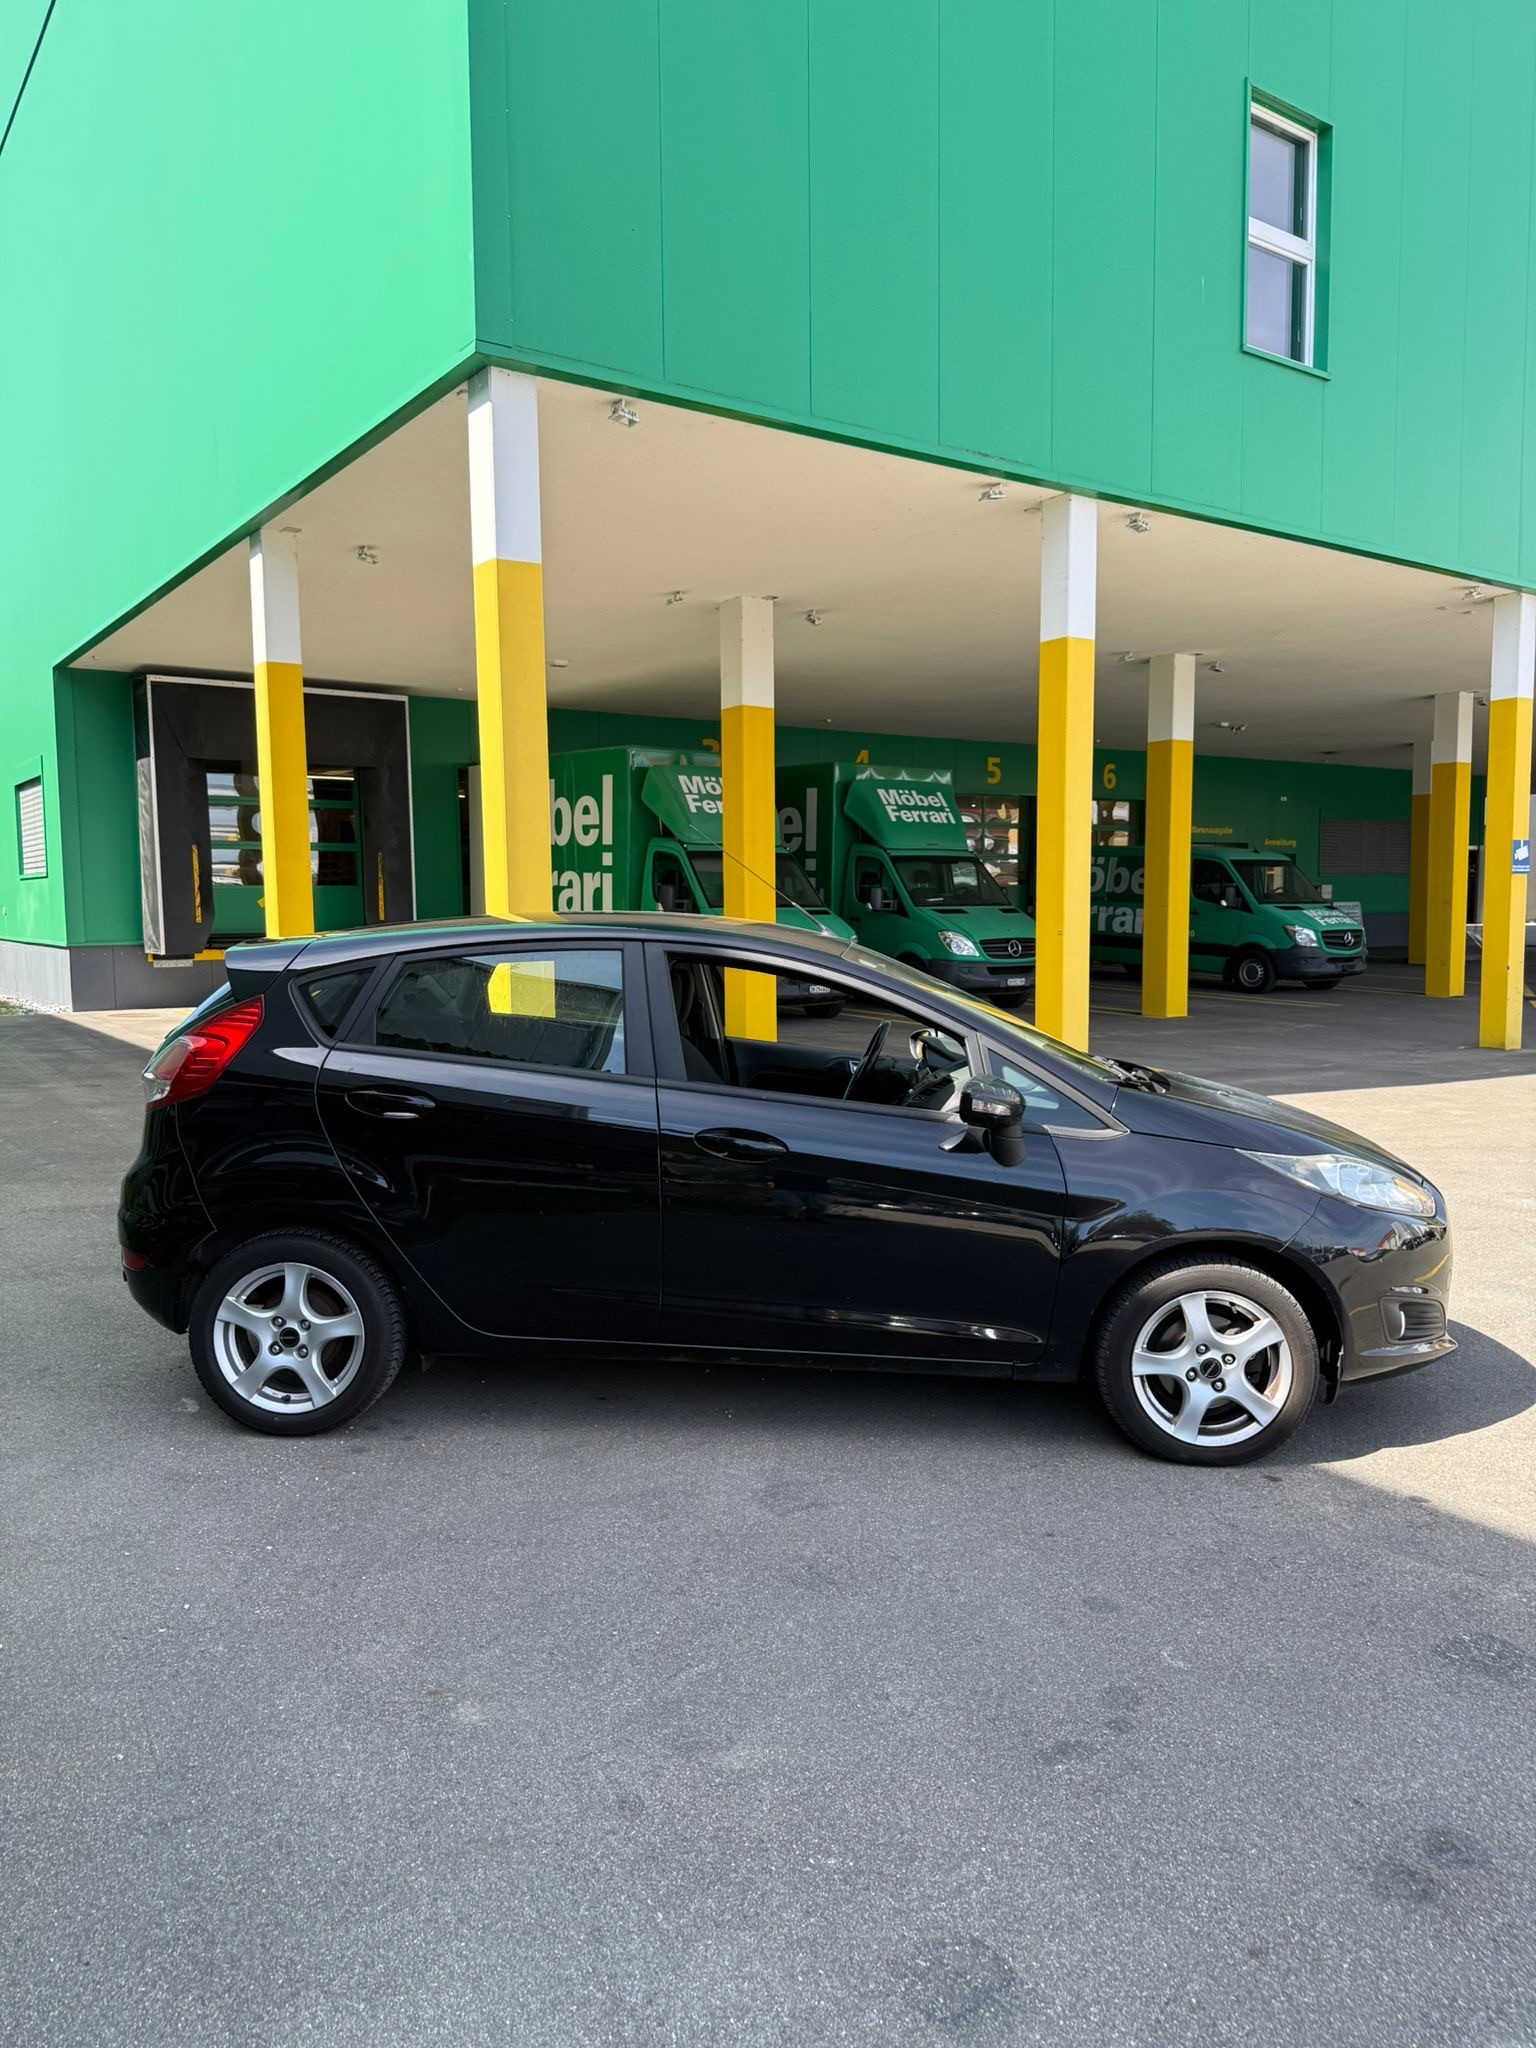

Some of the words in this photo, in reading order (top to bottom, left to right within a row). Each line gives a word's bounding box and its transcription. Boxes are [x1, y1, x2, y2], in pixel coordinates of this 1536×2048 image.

[986, 756, 1002, 784] 5
[1103, 763, 1117, 789] 6
[677, 774, 723, 795] Mö
[876, 788, 948, 807] Möbel
[549, 774, 613, 846] bel
[685, 793, 723, 814] Fer
[885, 805, 956, 824] Ferrari
[779, 787, 817, 853] el
[1091, 856, 1145, 895] öbe
